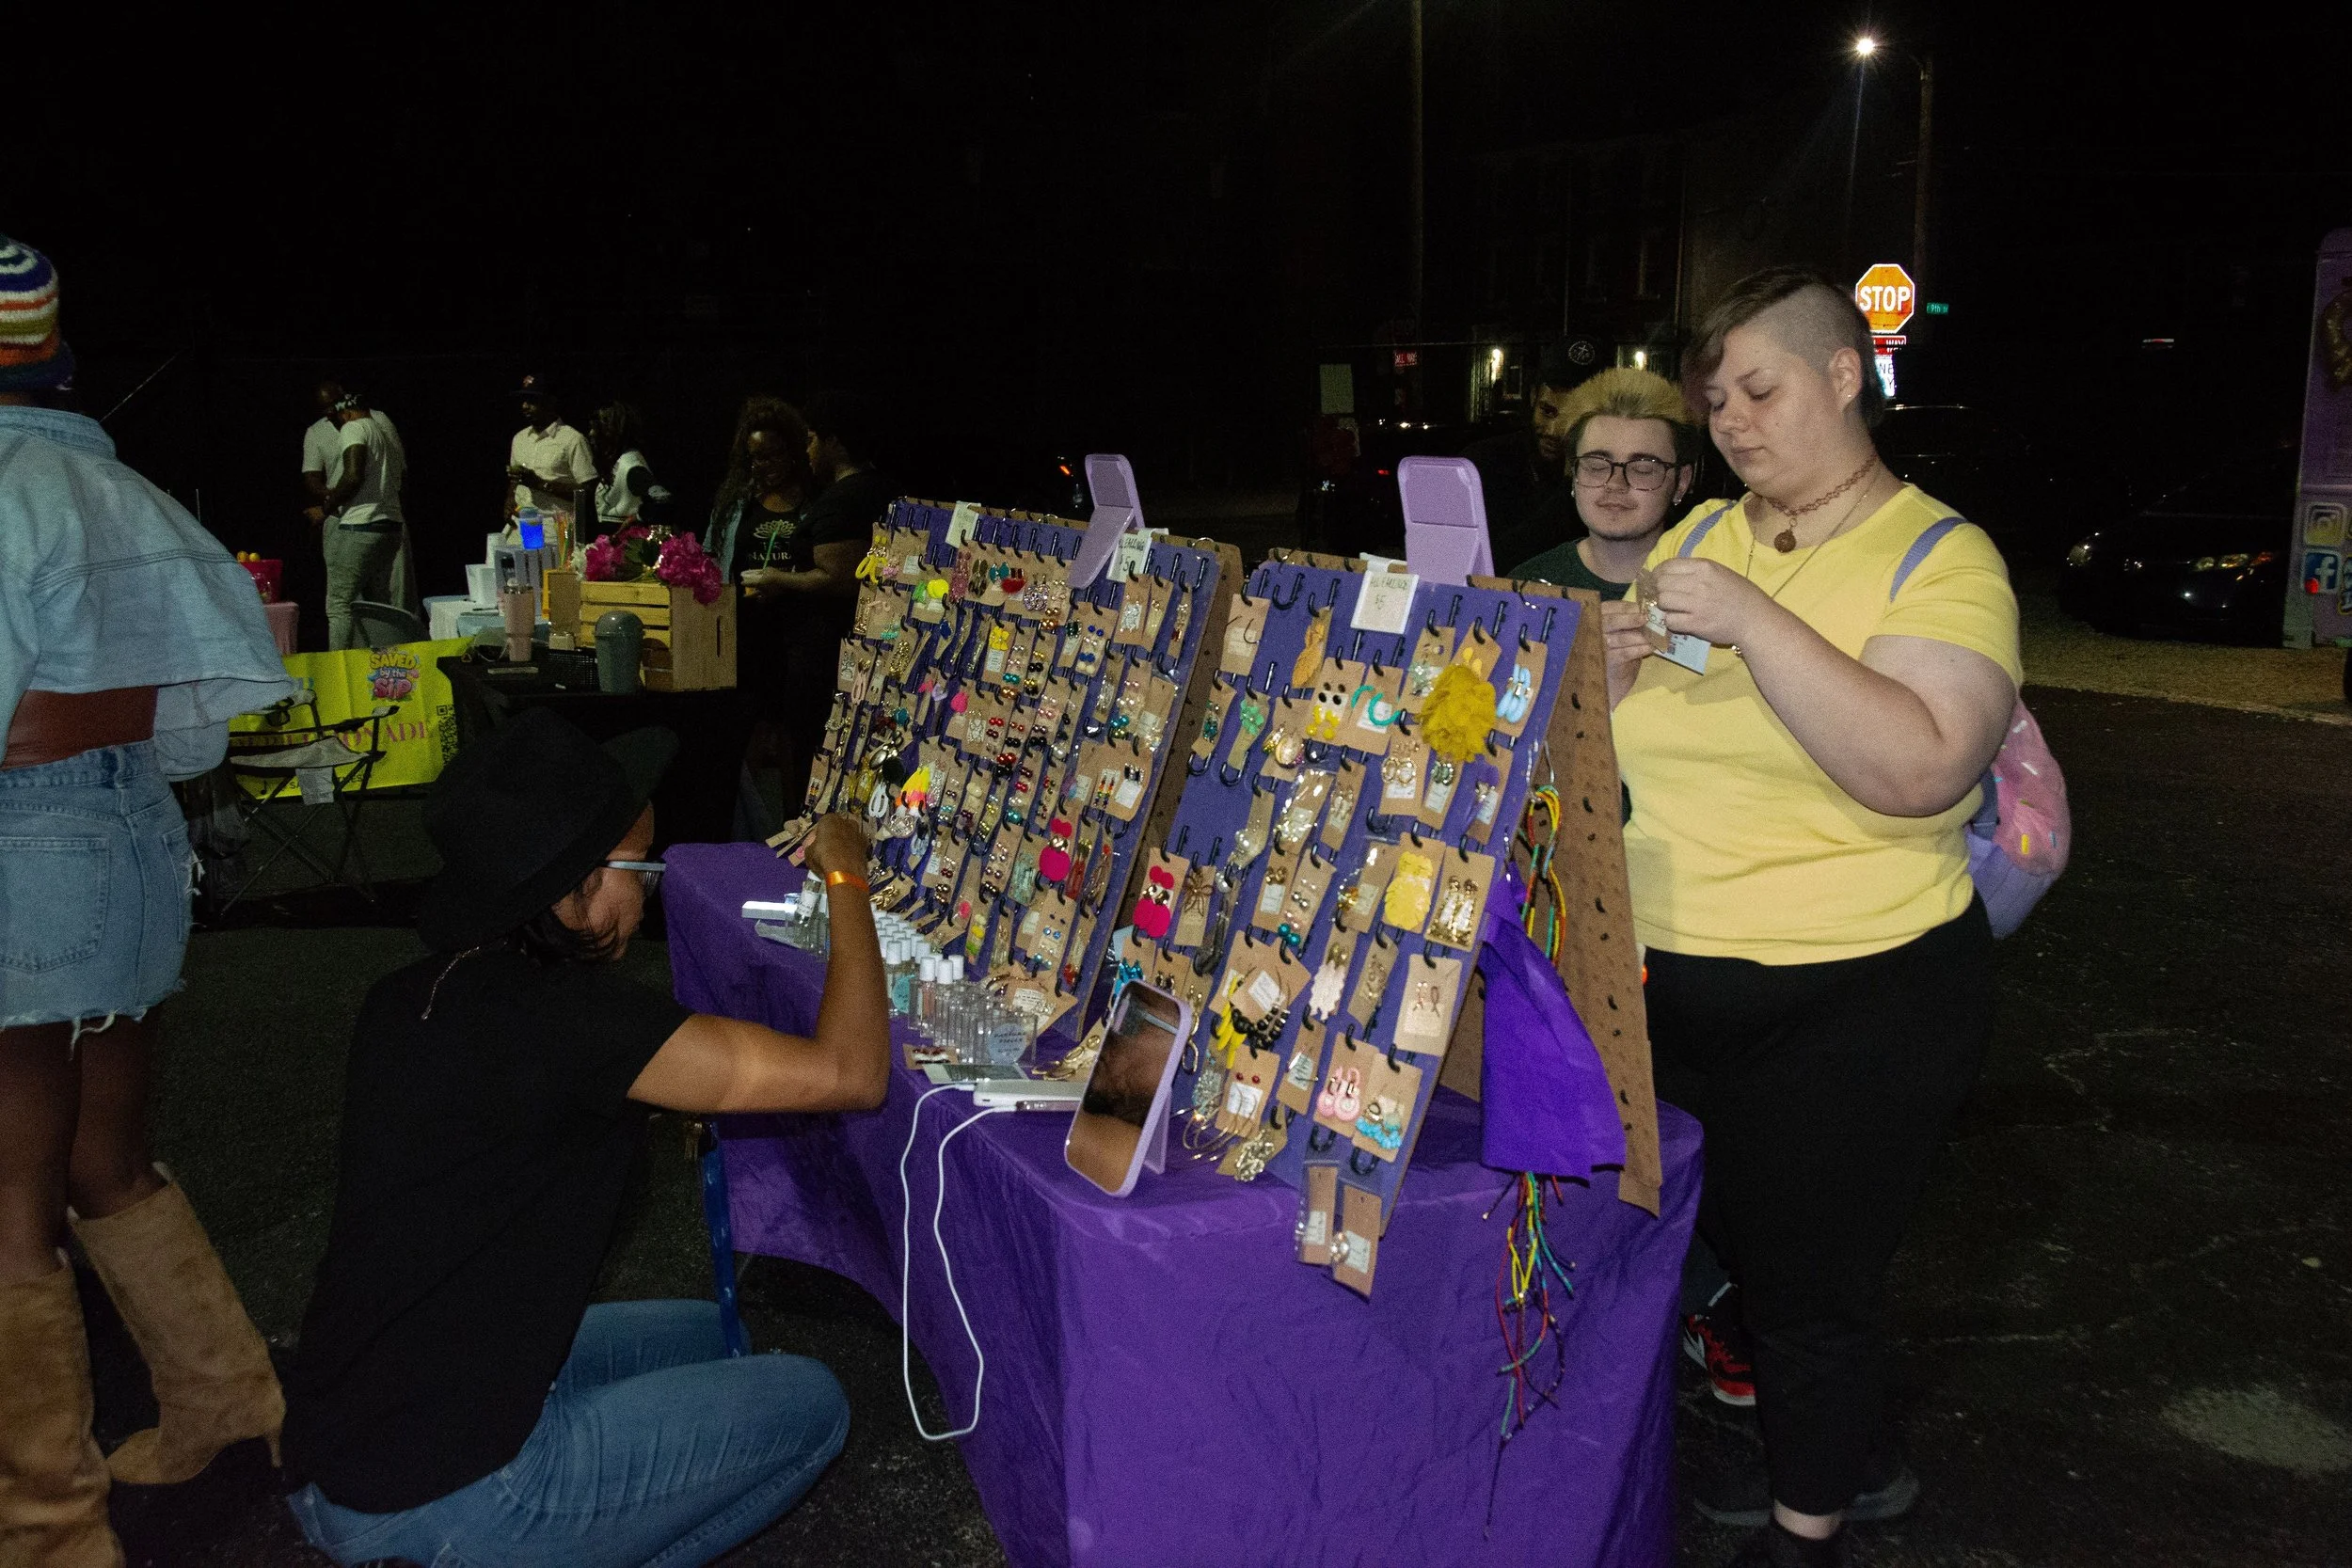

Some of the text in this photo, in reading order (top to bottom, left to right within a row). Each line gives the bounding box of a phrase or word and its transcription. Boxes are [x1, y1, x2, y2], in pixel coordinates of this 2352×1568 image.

[1859, 285, 1911, 311] STOP
[370, 653, 416, 670] SAVED
[380, 667, 406, 678] by the
[373, 677, 412, 699] SIP
